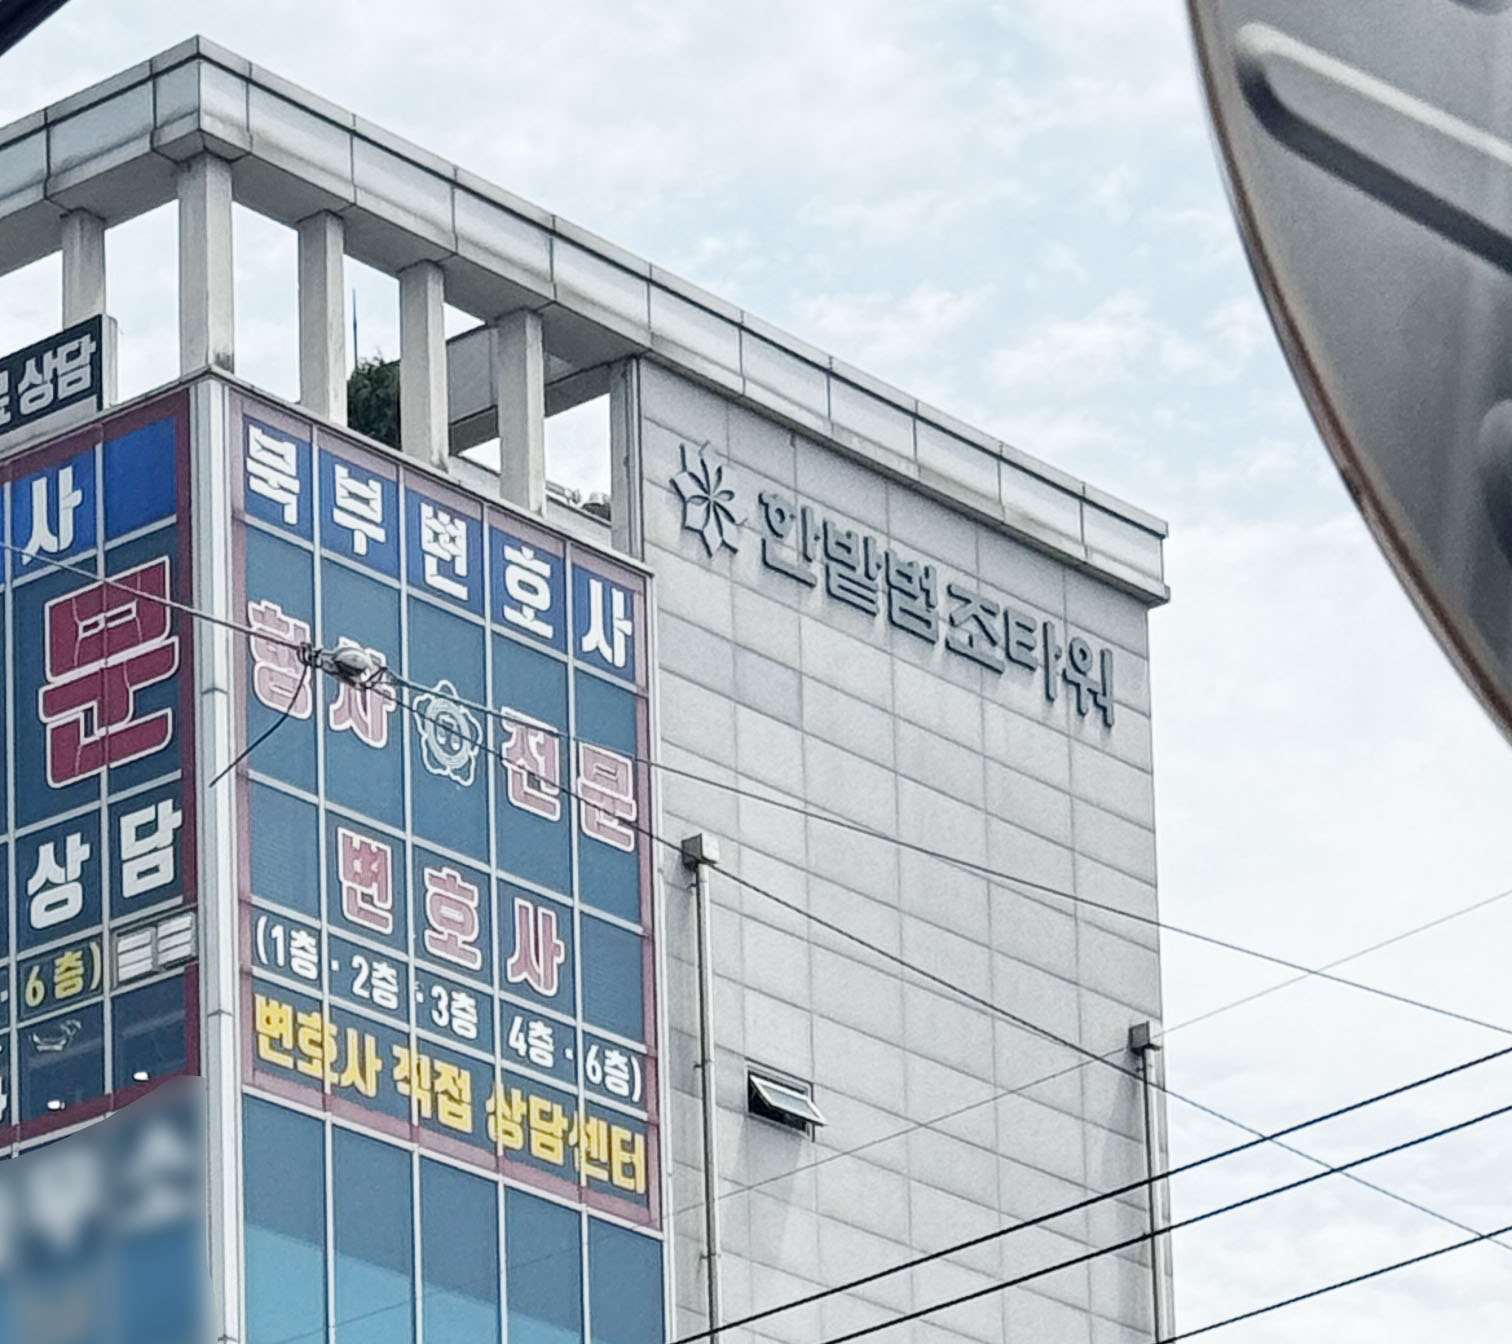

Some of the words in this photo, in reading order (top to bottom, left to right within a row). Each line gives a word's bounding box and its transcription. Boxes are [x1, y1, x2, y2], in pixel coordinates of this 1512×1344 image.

[17, 335, 98, 411] 상담
[500, 705, 637, 853] 전문
[336, 827, 565, 997] 변호사
[254, 993, 383, 1098] 변호사
[392, 1043, 474, 1134] 직접
